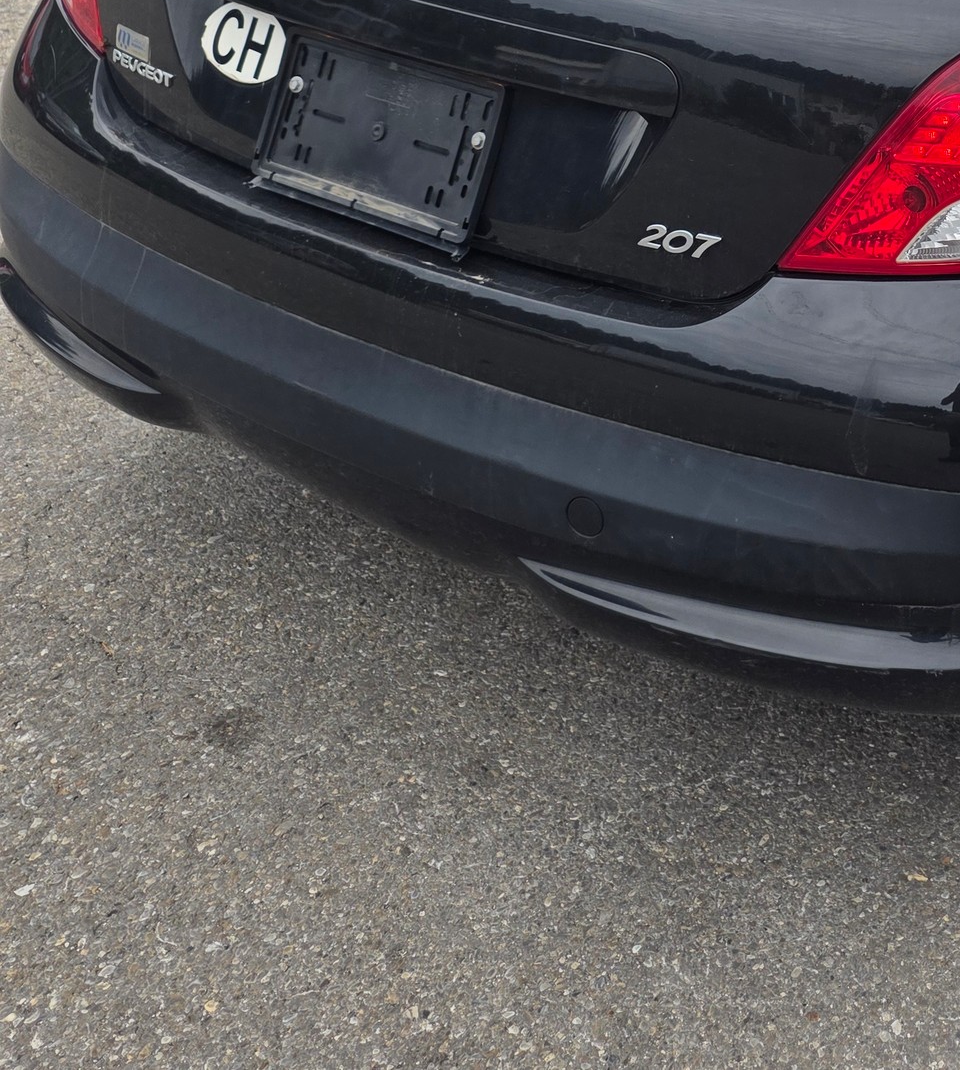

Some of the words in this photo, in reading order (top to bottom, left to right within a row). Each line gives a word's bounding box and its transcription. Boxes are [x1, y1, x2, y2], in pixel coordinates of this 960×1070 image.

[212, 8, 276, 80] CH
[112, 48, 174, 87] PEUGEOT
[637, 223, 722, 259] 207
